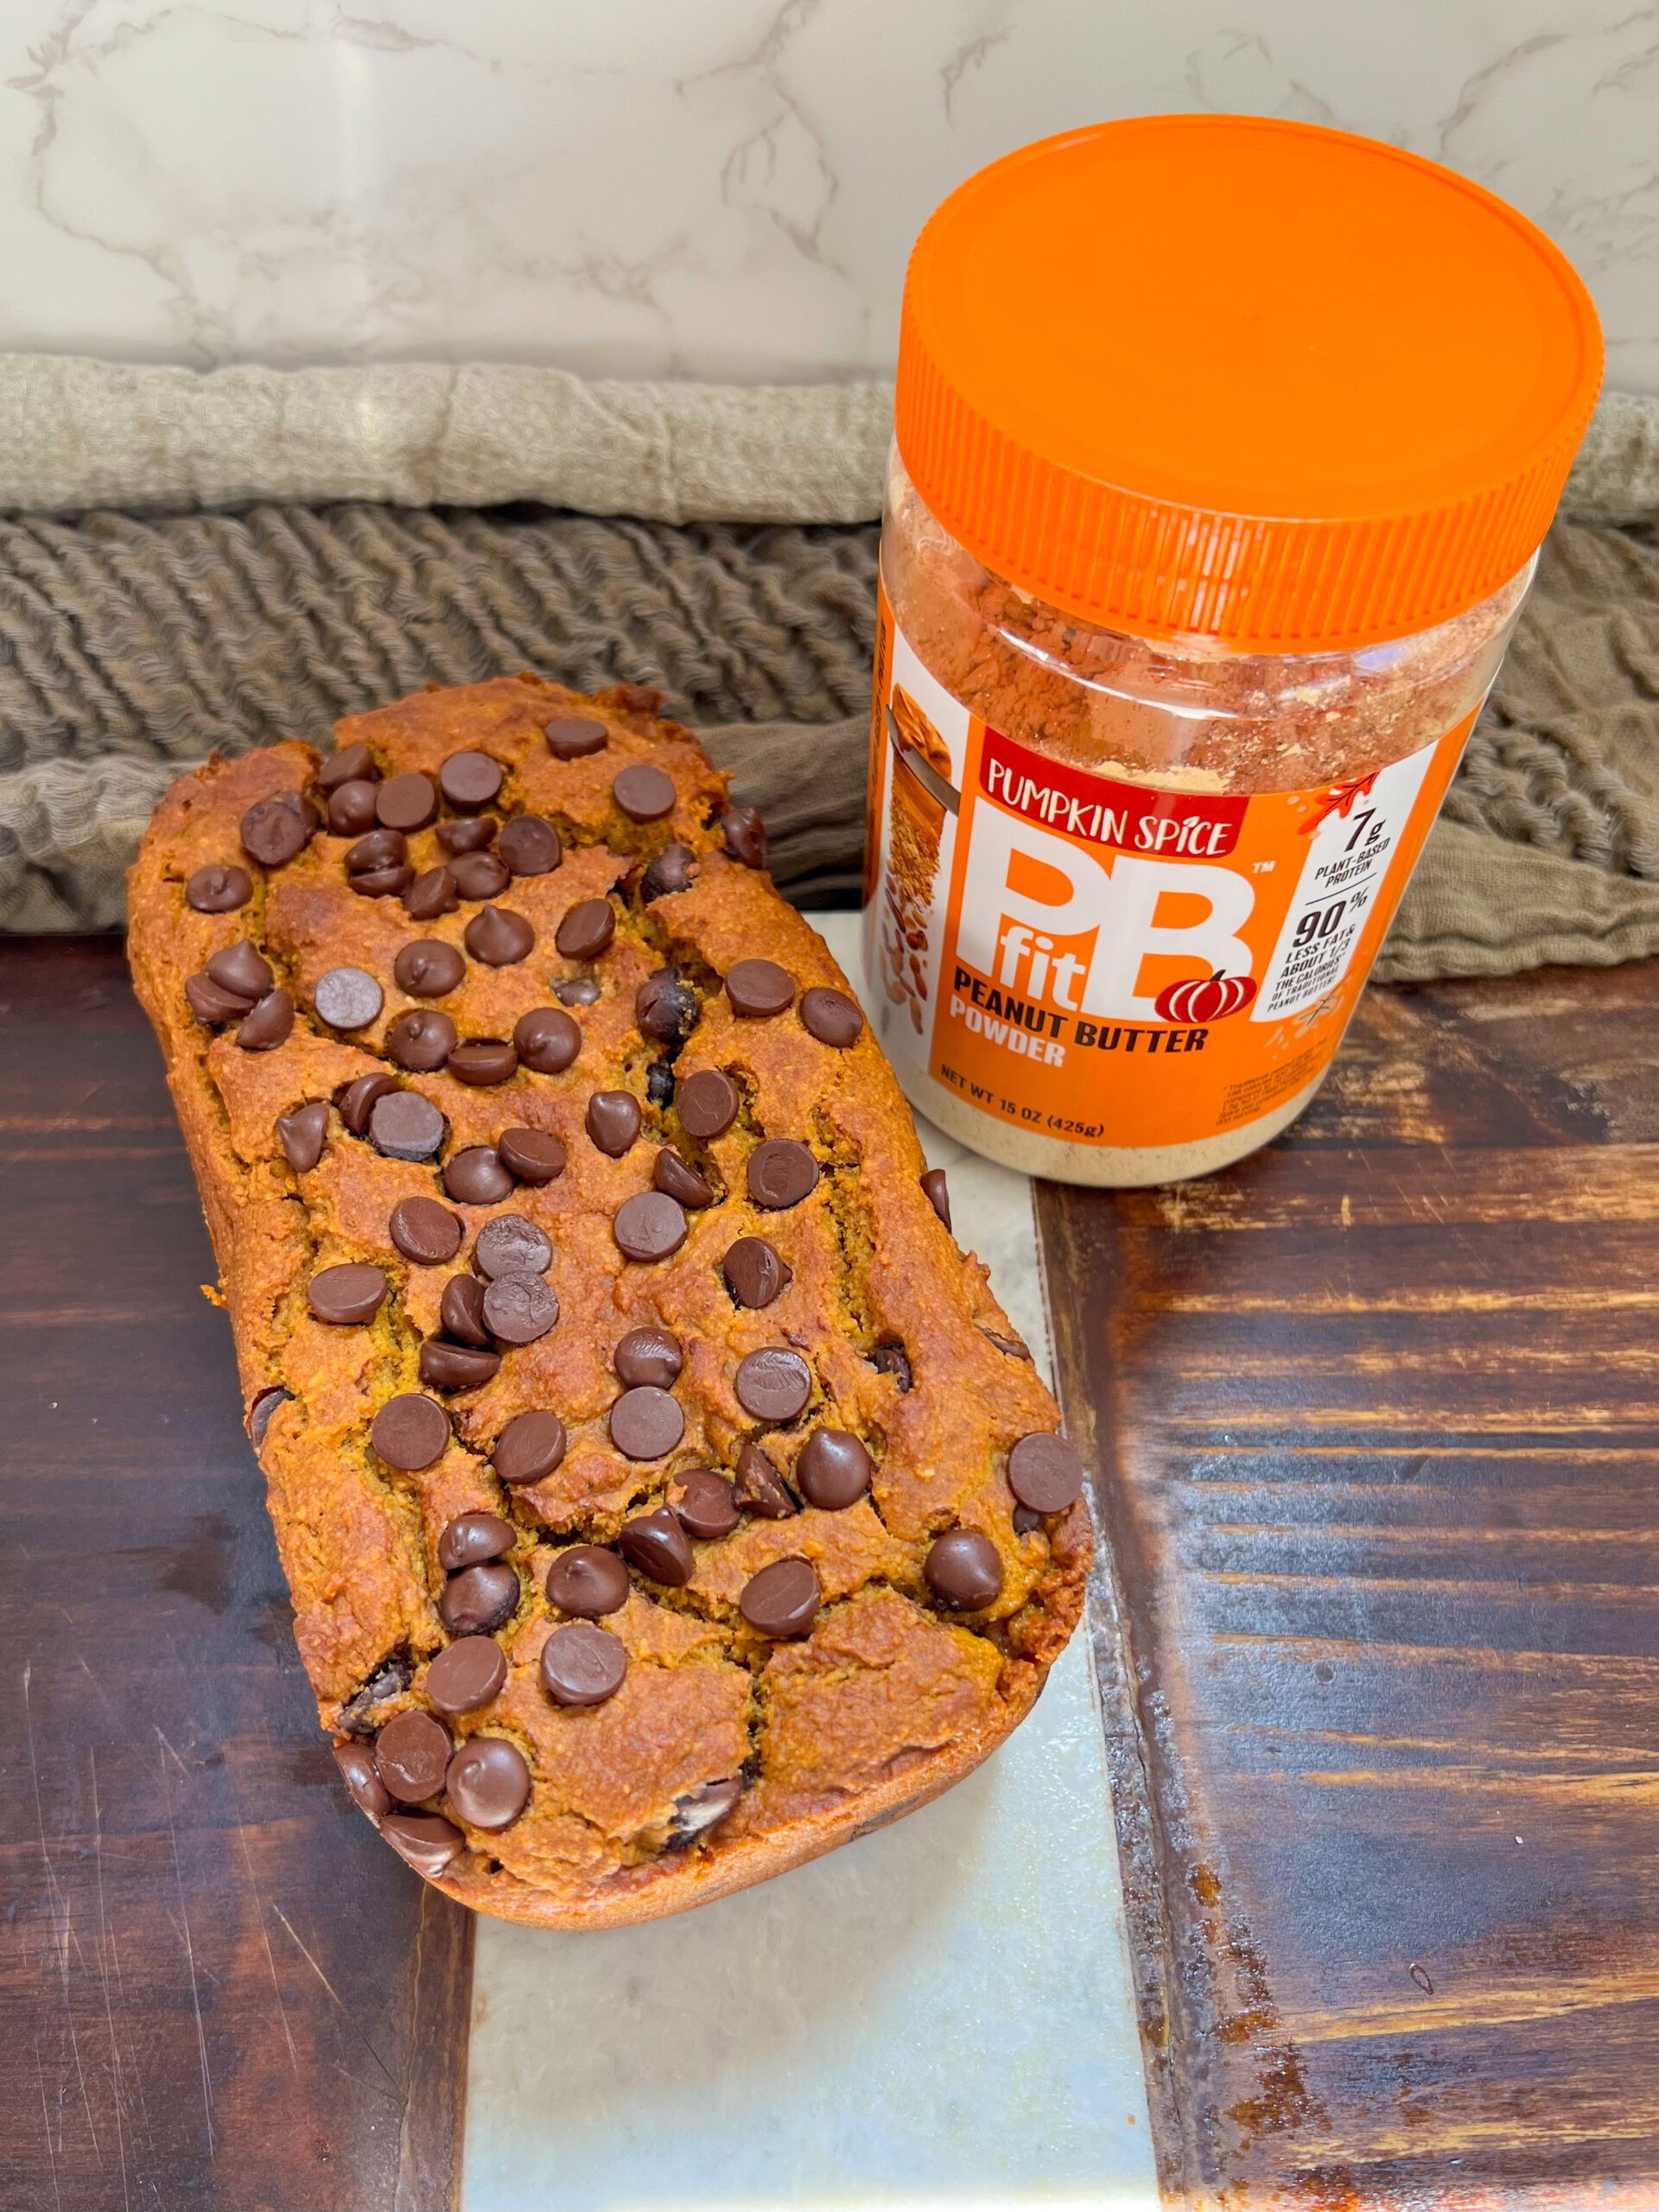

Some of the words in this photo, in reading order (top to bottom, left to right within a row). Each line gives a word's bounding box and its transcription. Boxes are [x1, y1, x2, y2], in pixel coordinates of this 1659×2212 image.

[988, 758, 1128, 844] PUMPKIN
[1134, 816, 1233, 855] SPICE
[1344, 806, 1386, 852] 7g
[1314, 837, 1391, 880] PLANT-BASED
[1325, 859, 1373, 888] PROTEIN
[1292, 885, 1369, 948] 90%
[1000, 925, 1086, 1012] fit
[1280, 951, 1327, 979] ABOUT
[1330, 938, 1351, 957] 1/3
[1285, 942, 1320, 963] LESS
[1267, 994, 1300, 1013] PEANUT
[1272, 992, 1283, 1001] OF
[1286, 964, 1338, 996] TRADITIONAL
[1275, 976, 1295, 991] THE
[954, 965, 1068, 1039] PEANUT
[1074, 1021, 1209, 1053] BUTTER
[950, 995, 1066, 1068] POWDER
[941, 1064, 967, 1090] NET
[970, 1083, 994, 1104] WT
[1000, 1098, 1016, 1115] 15
[1021, 1107, 1042, 1123] OZ
[1047, 1116, 1104, 1137] (425g)
